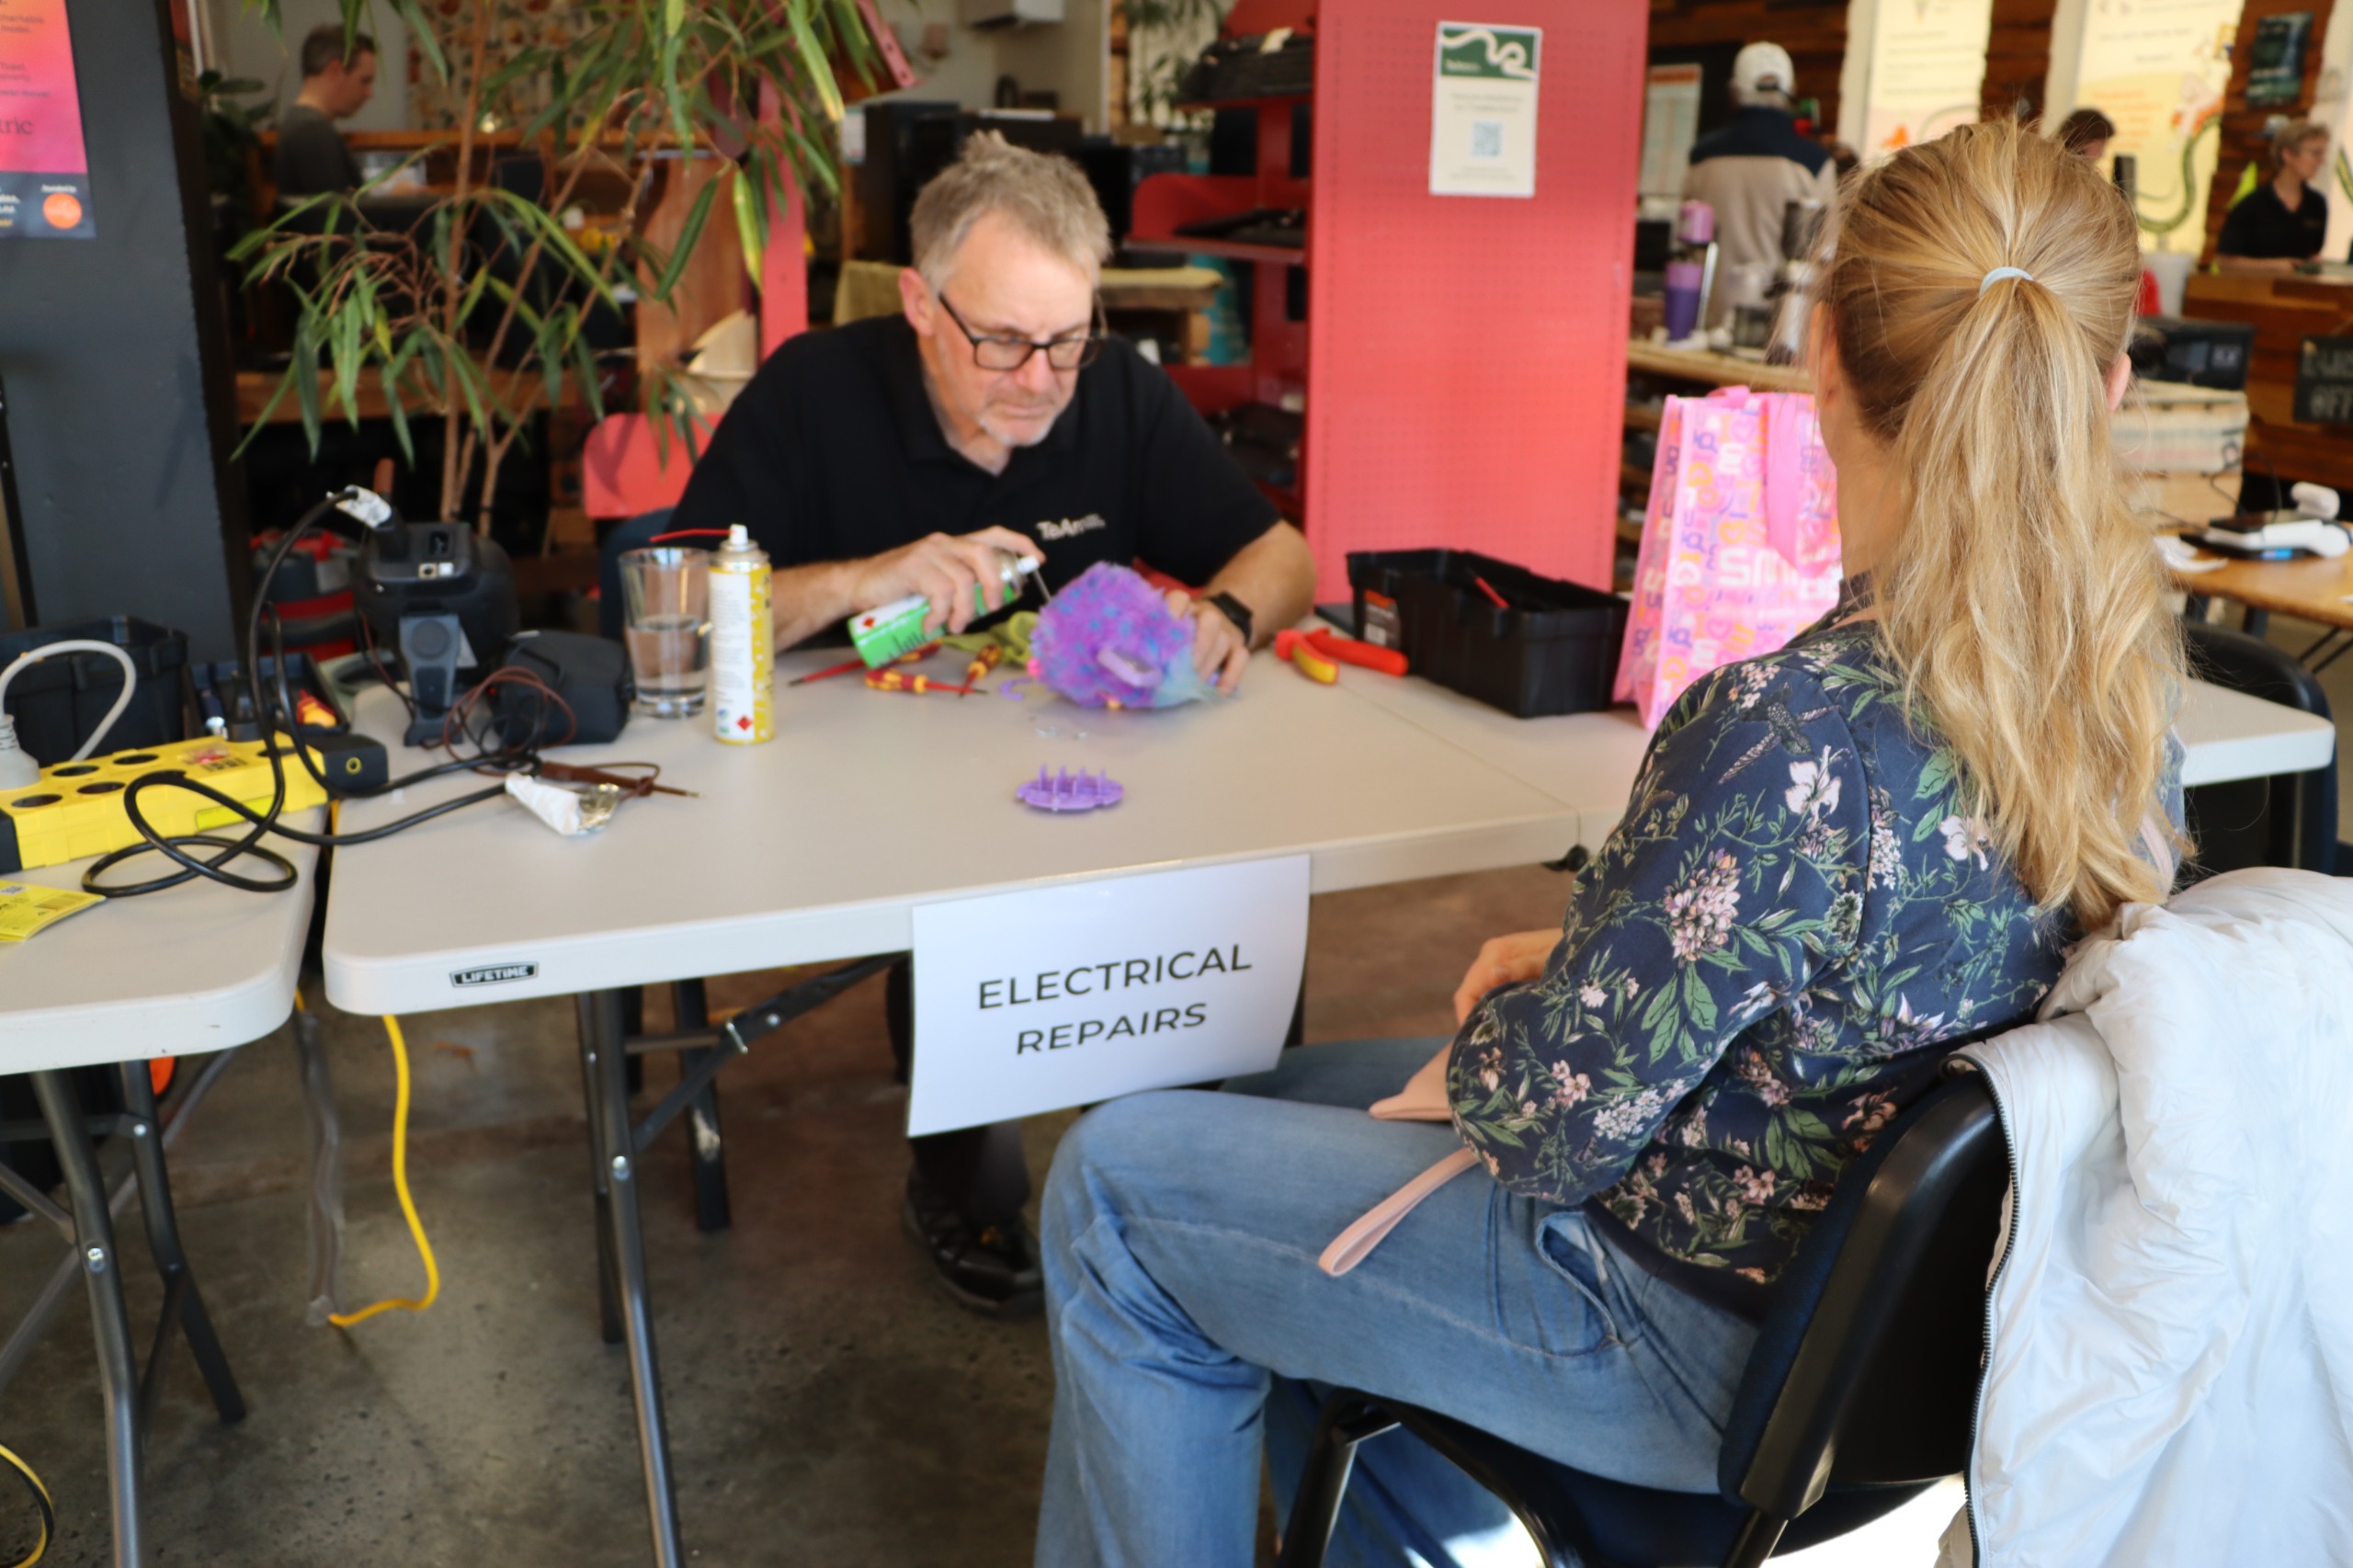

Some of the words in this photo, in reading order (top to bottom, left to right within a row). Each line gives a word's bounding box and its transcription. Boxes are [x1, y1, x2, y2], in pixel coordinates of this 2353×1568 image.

[461, 965, 529, 983] LIFETIME
[979, 944, 1253, 1009] ELECTRICAL
[1017, 1003, 1207, 1054] REPAIRS
